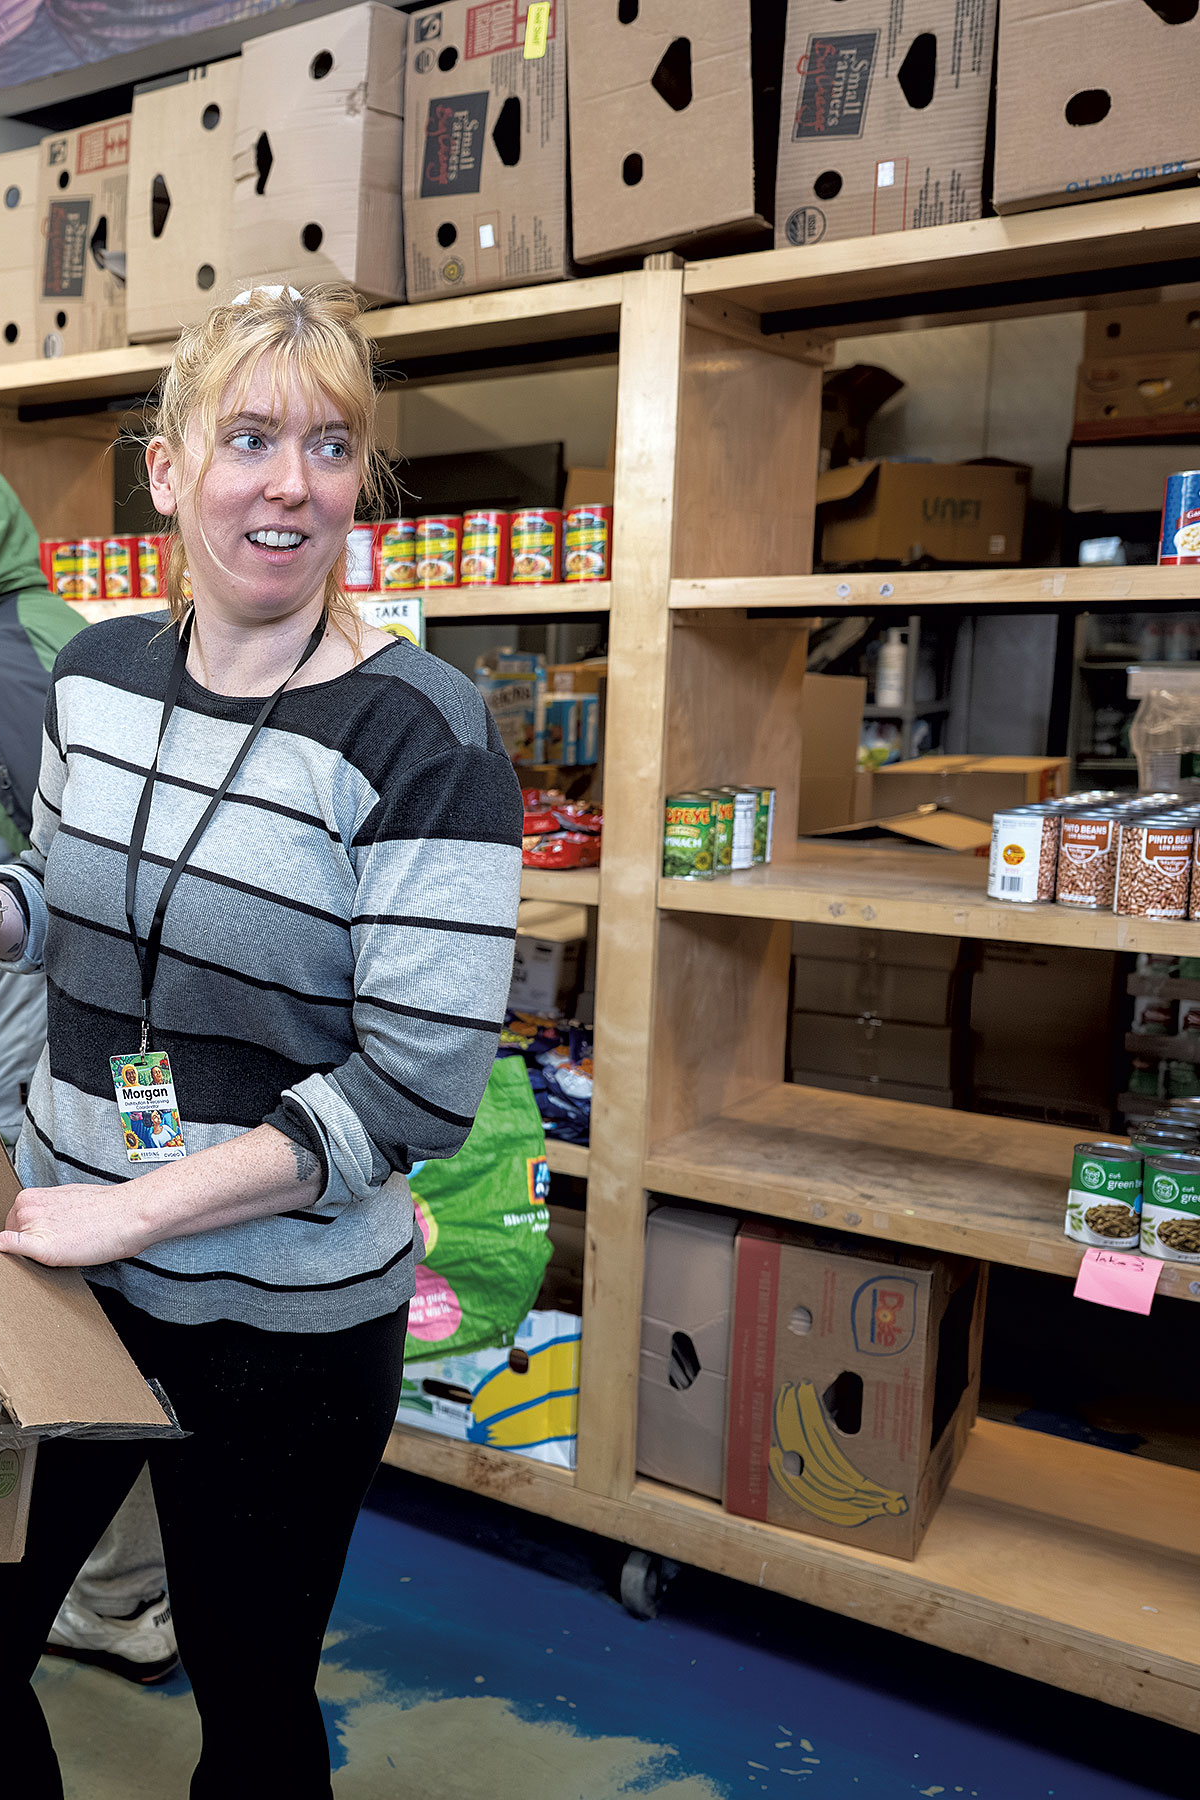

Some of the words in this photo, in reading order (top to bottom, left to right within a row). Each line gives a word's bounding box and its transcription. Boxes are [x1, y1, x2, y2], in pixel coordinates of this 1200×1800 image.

[827, 48, 857, 127] Farmers
[843, 58, 869, 116] Small
[448, 110, 469, 181] Farmers
[459, 119, 479, 171] Small
[375, 605, 409, 618] TAKE
[665, 806, 711, 825] OPEYE
[1080, 824, 1107, 836] BEANS
[1148, 834, 1174, 845] PINTO
[122, 1087, 169, 1101] Morgan
[1108, 1172, 1121, 1180] cut
[1107, 1180, 1134, 1191] green
[1181, 1194, 1200, 1205] gre
[503, 1211, 536, 1228] Shop
[877, 1290, 905, 1347] Dole
